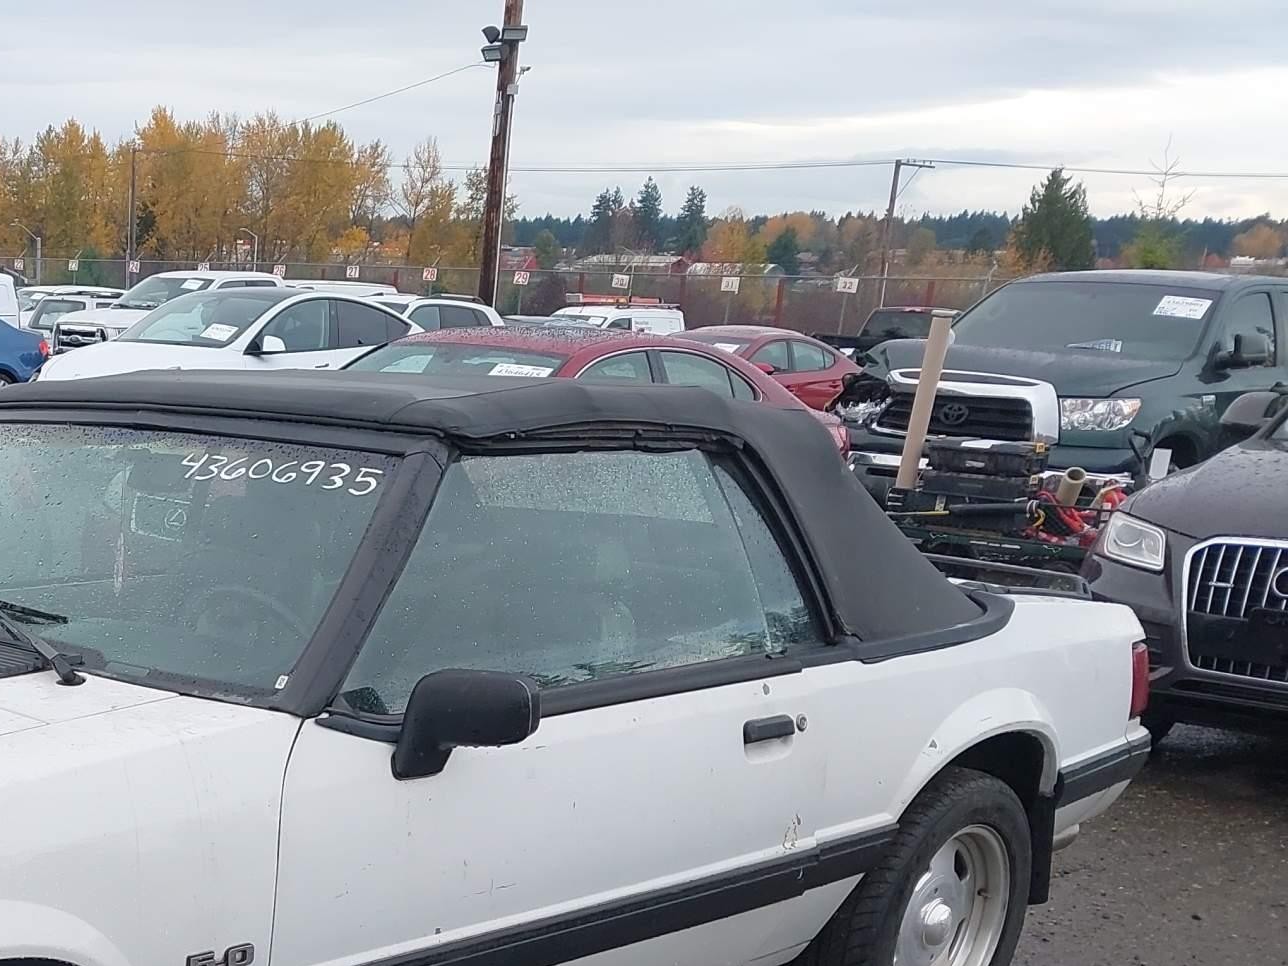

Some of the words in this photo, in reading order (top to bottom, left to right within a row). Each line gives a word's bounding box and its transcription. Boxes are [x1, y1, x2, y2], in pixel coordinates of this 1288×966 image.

[130, 262, 140, 271] 24
[274, 266, 285, 276] 26
[348, 266, 359, 277] 27
[424, 269, 436, 279] 28
[515, 272, 528, 284] 29
[181, 453, 384, 496] 43606935
